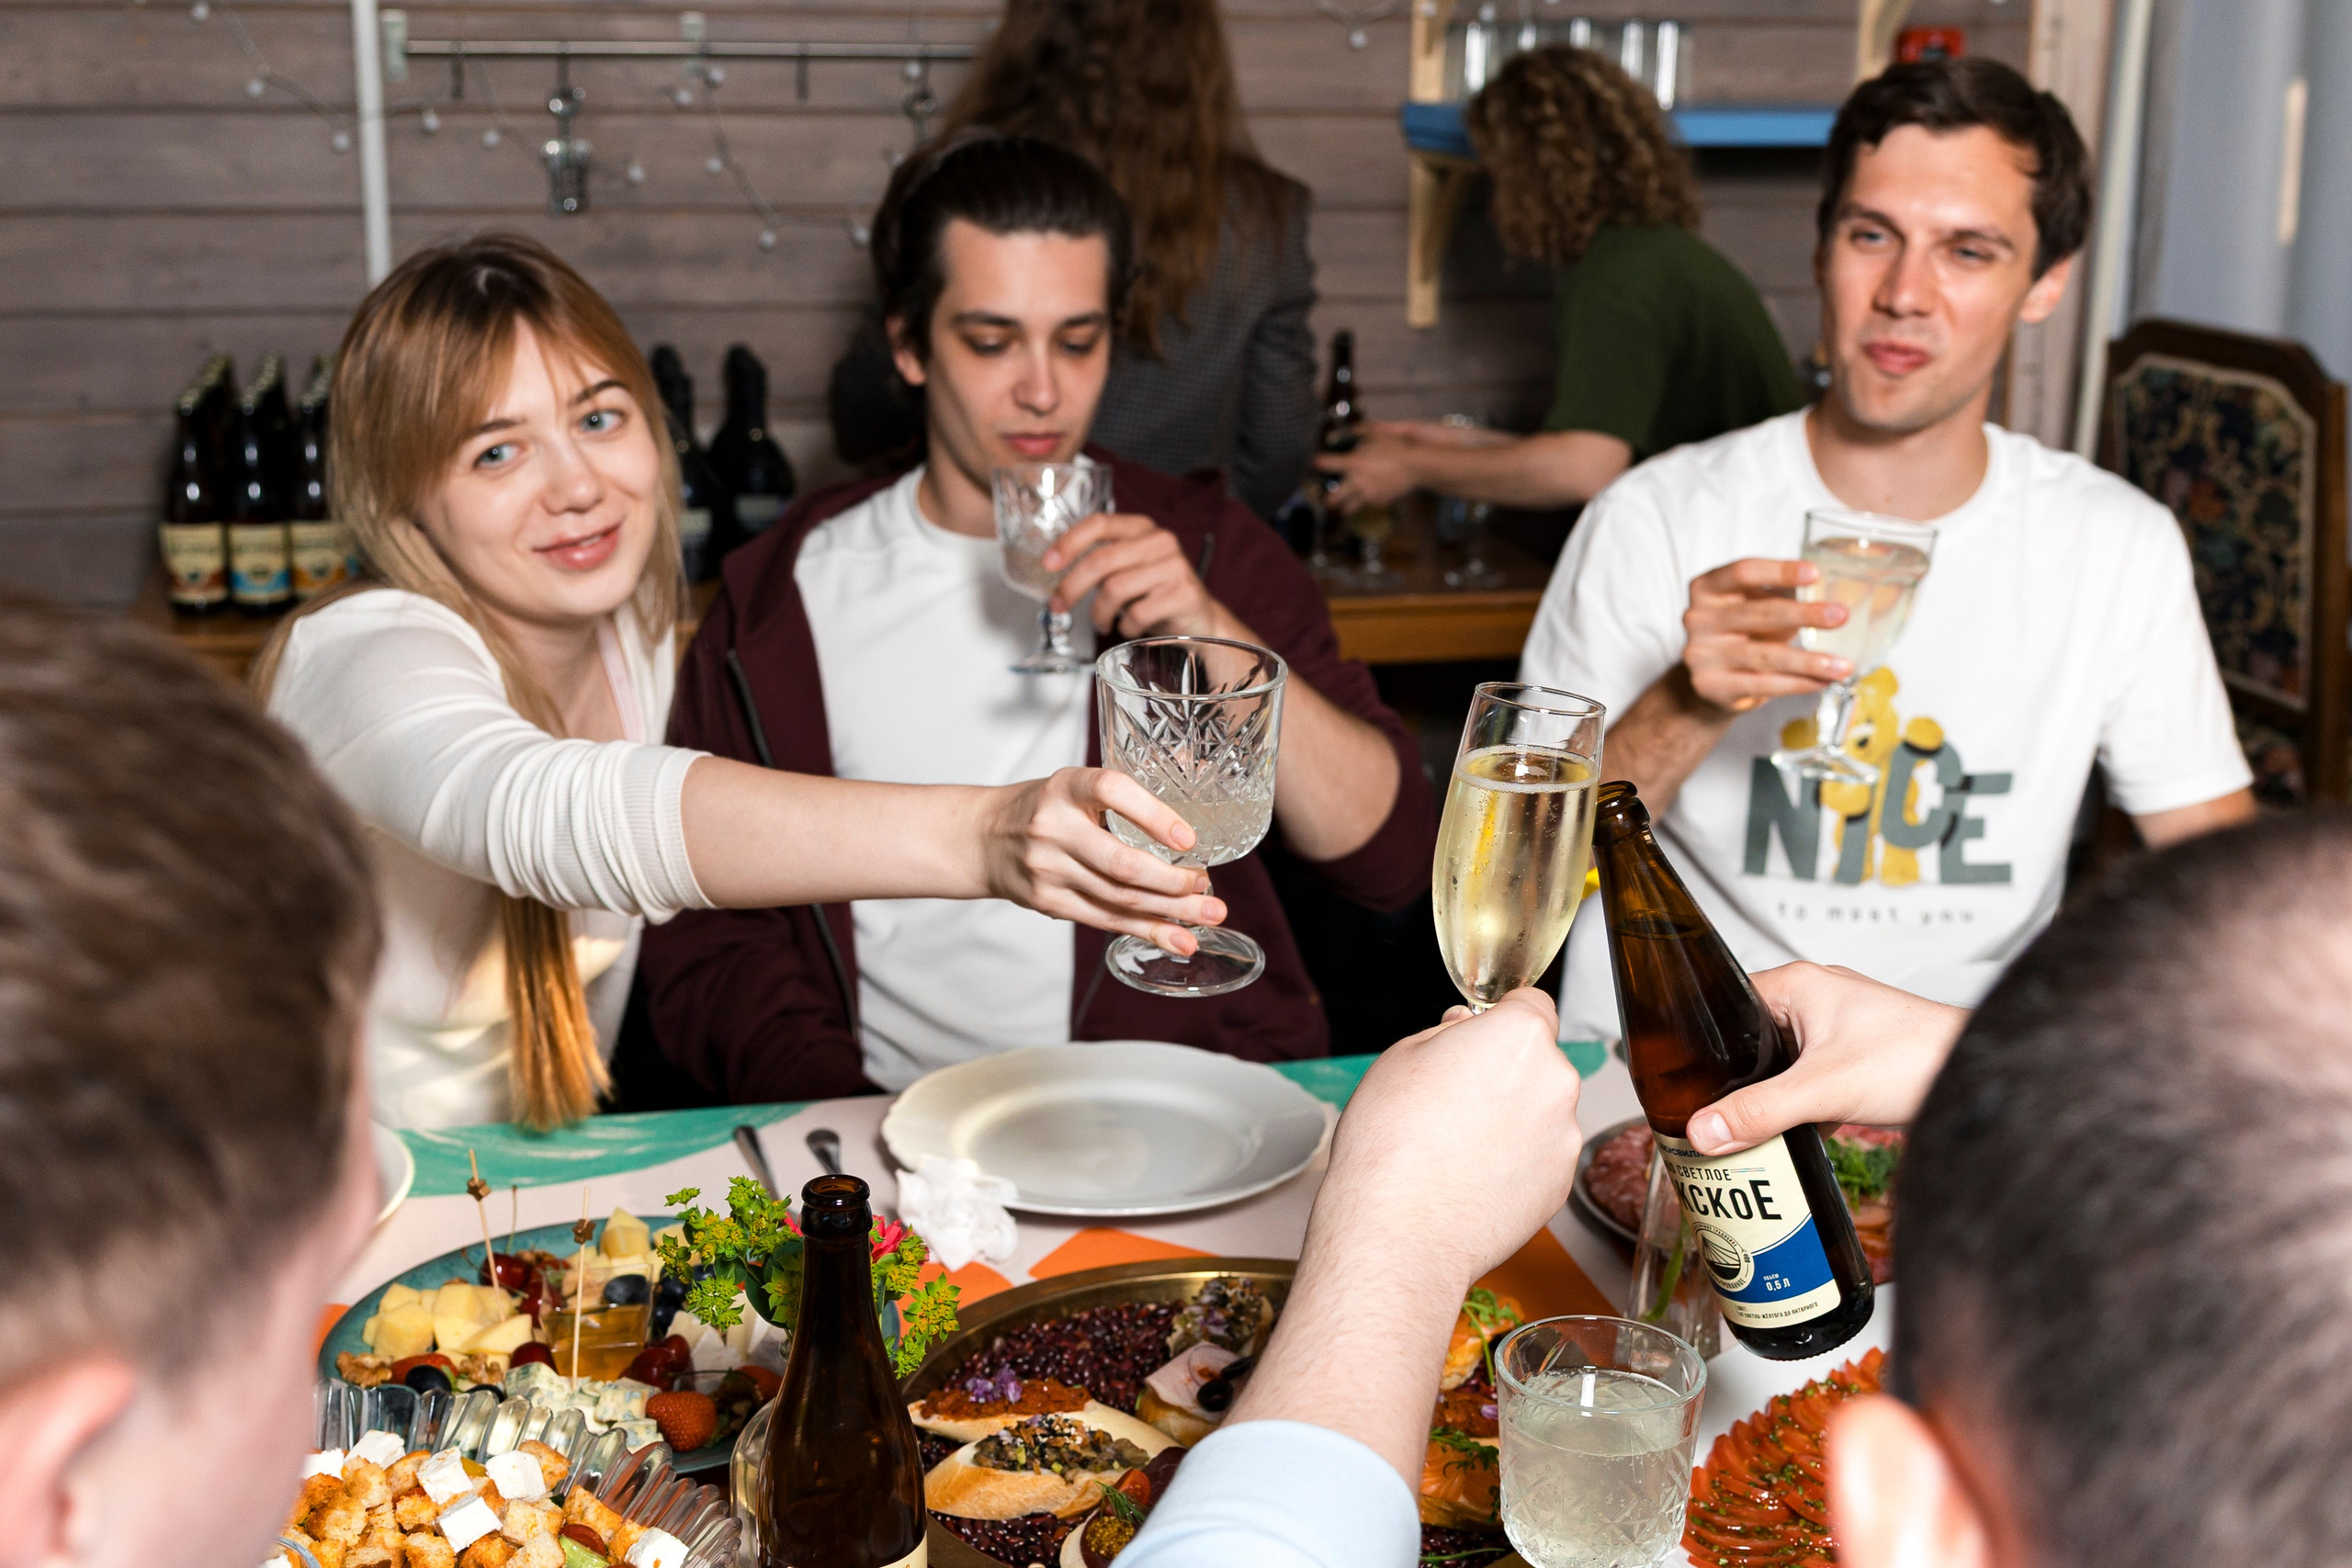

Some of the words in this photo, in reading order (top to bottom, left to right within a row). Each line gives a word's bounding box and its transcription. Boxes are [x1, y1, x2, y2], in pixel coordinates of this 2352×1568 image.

[1742, 739, 2013, 886] NICE
[1778, 900, 1808, 921] to
[1826, 904, 1898, 923] meet
[1919, 908, 1974, 927] you
[1677, 1165, 1732, 1180] СВЕТЛОЕ
[1766, 1280, 1782, 1292] 0,5
